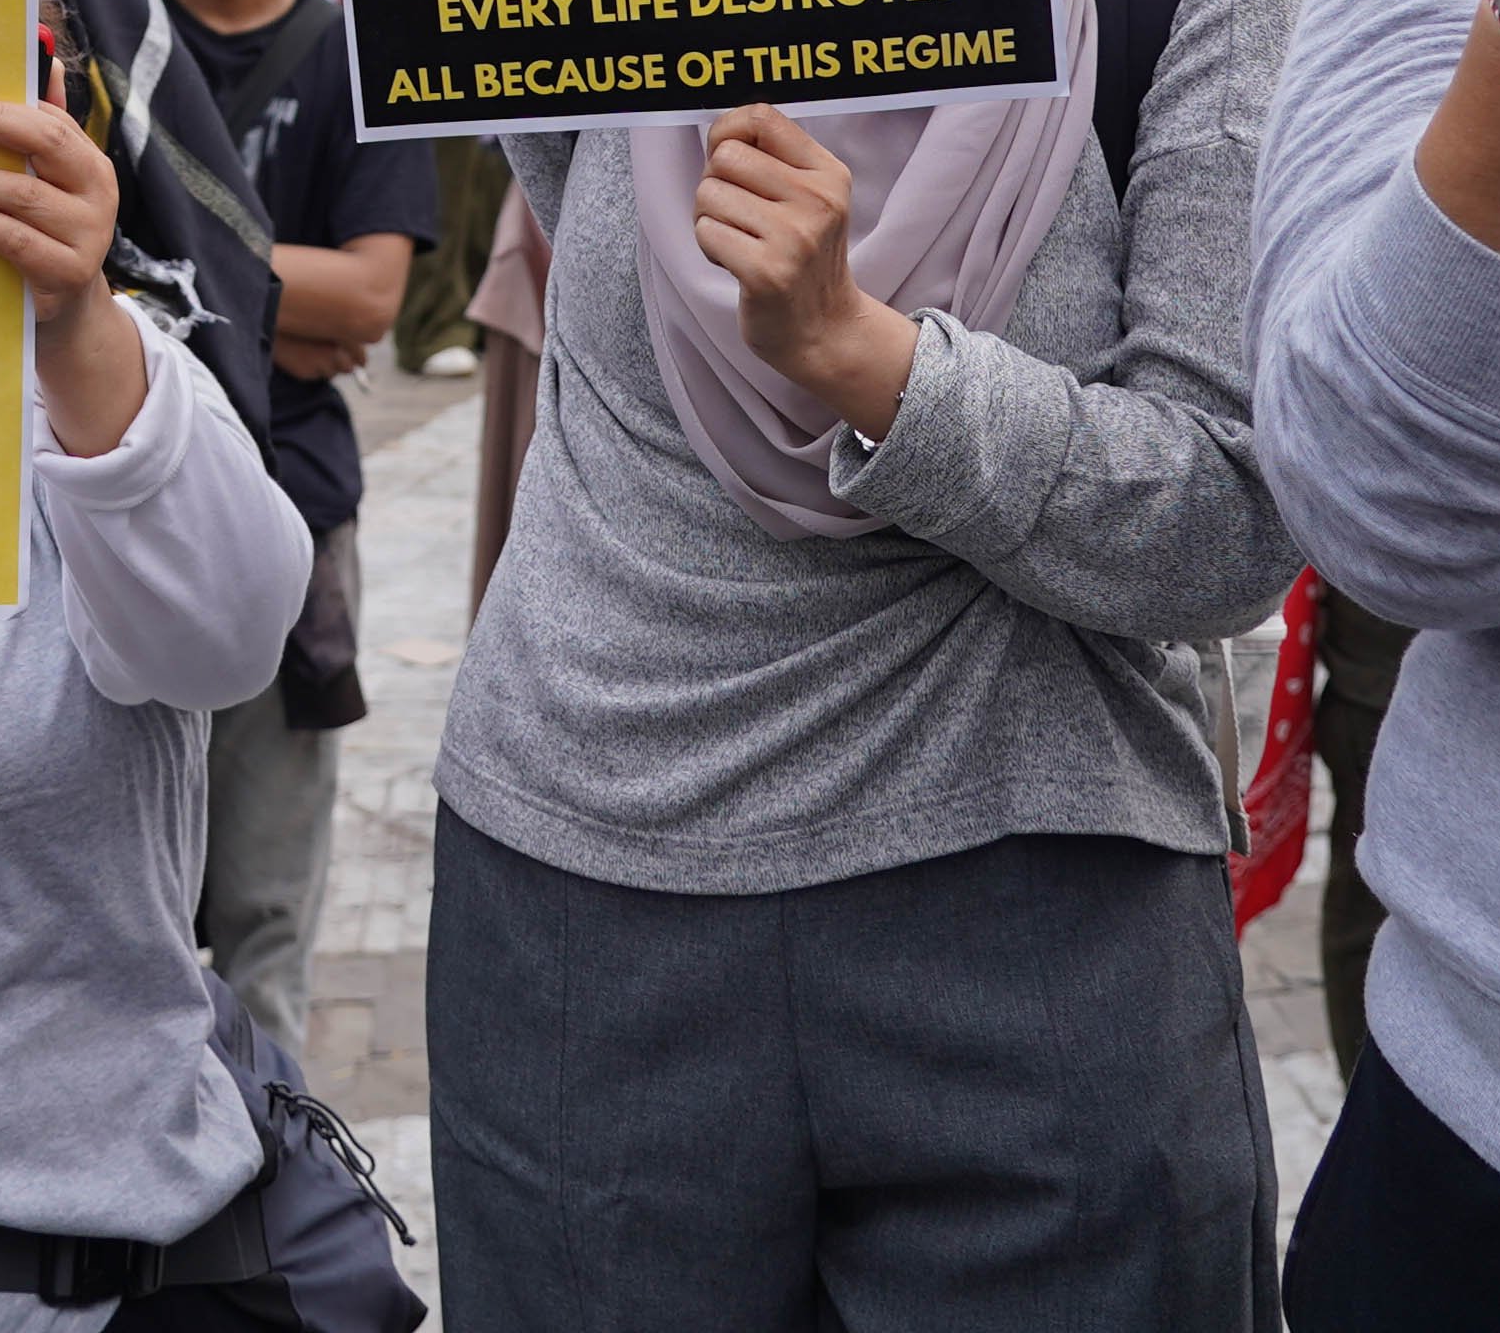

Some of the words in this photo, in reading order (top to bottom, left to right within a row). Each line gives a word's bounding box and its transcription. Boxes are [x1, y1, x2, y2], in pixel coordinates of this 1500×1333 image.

[386, 64, 465, 105] ALL
[476, 53, 667, 99] BECAUSE
[677, 47, 736, 88] OF
[744, 41, 842, 83] THIS
[853, 27, 1017, 75] REGIME
